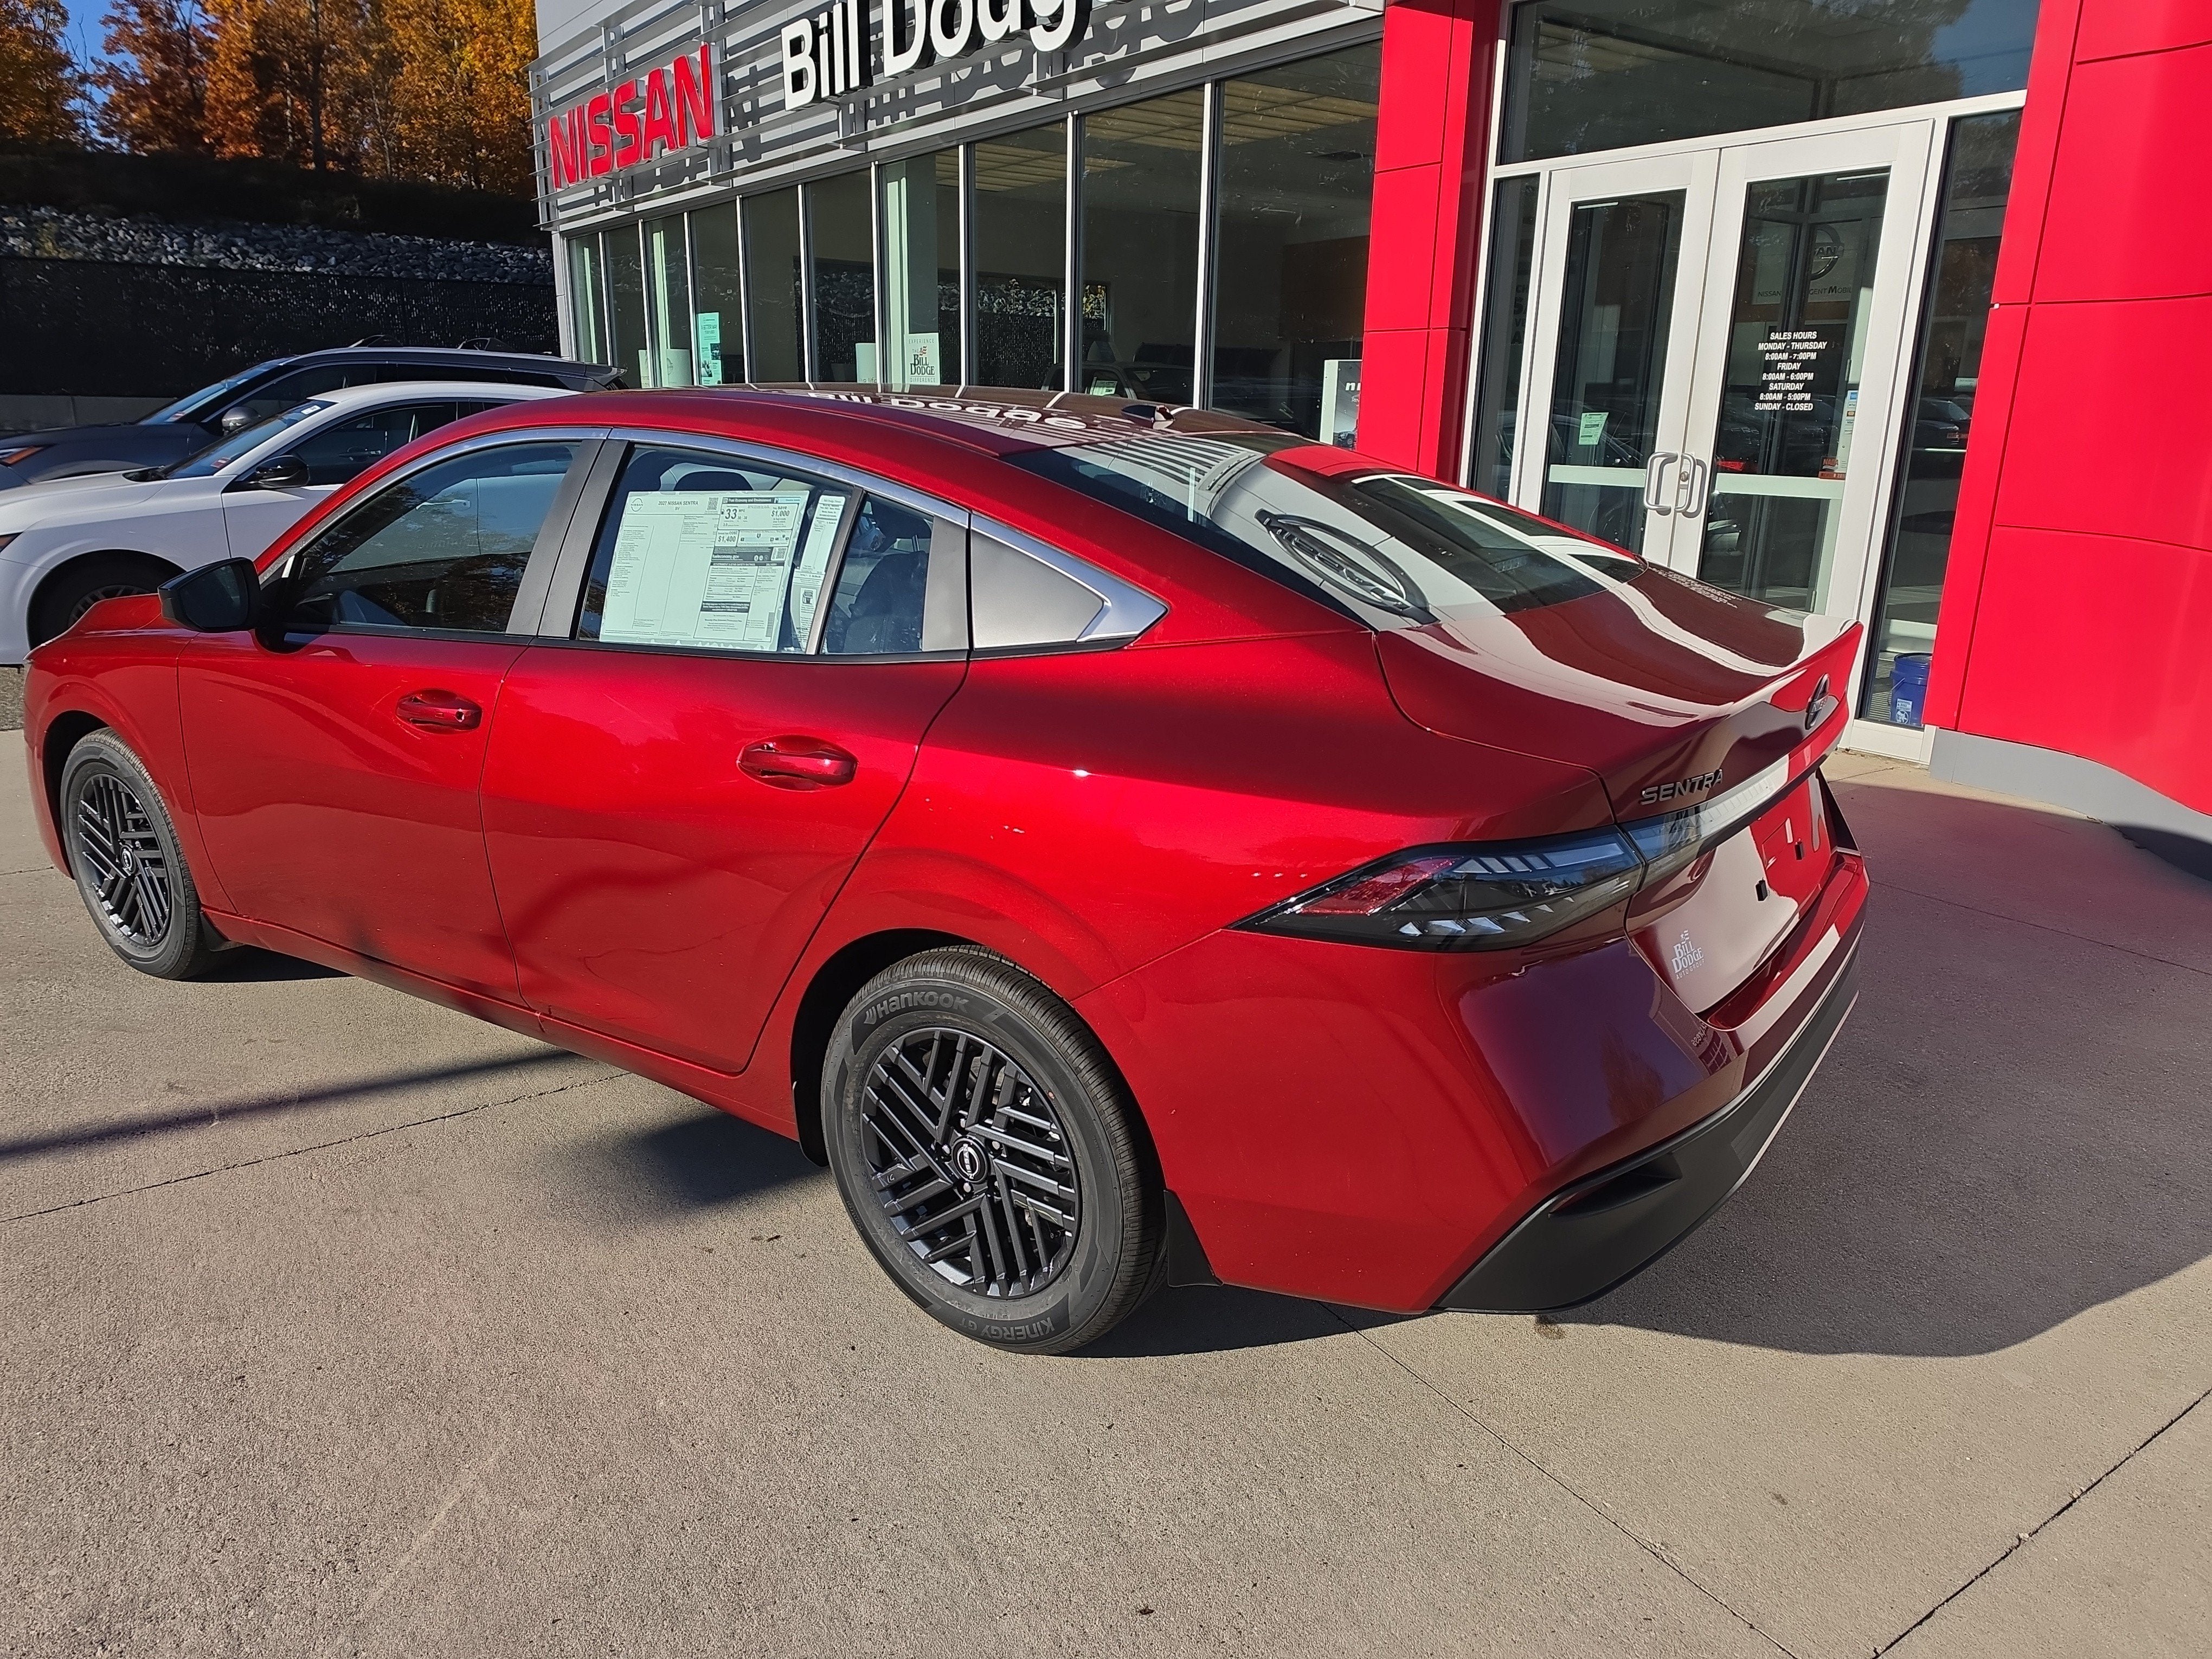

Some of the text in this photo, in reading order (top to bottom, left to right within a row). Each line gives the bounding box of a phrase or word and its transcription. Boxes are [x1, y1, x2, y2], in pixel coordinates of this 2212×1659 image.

[781, 0, 1123, 111] Bill Dog
[549, 42, 713, 191] NISSAN
[1758, 342, 1786, 350] MONDAY
[1791, 342, 1827, 350] THURSDAY
[910, 363, 935, 375] DODGE
[913, 354, 929, 365] BILL
[725, 509, 737, 519] 33
[1640, 769, 1723, 805] SENTRA
[1671, 947, 1704, 973] DODGE
[1673, 941, 1695, 959] BILL
[963, 1143, 974, 1179] NISSAN
